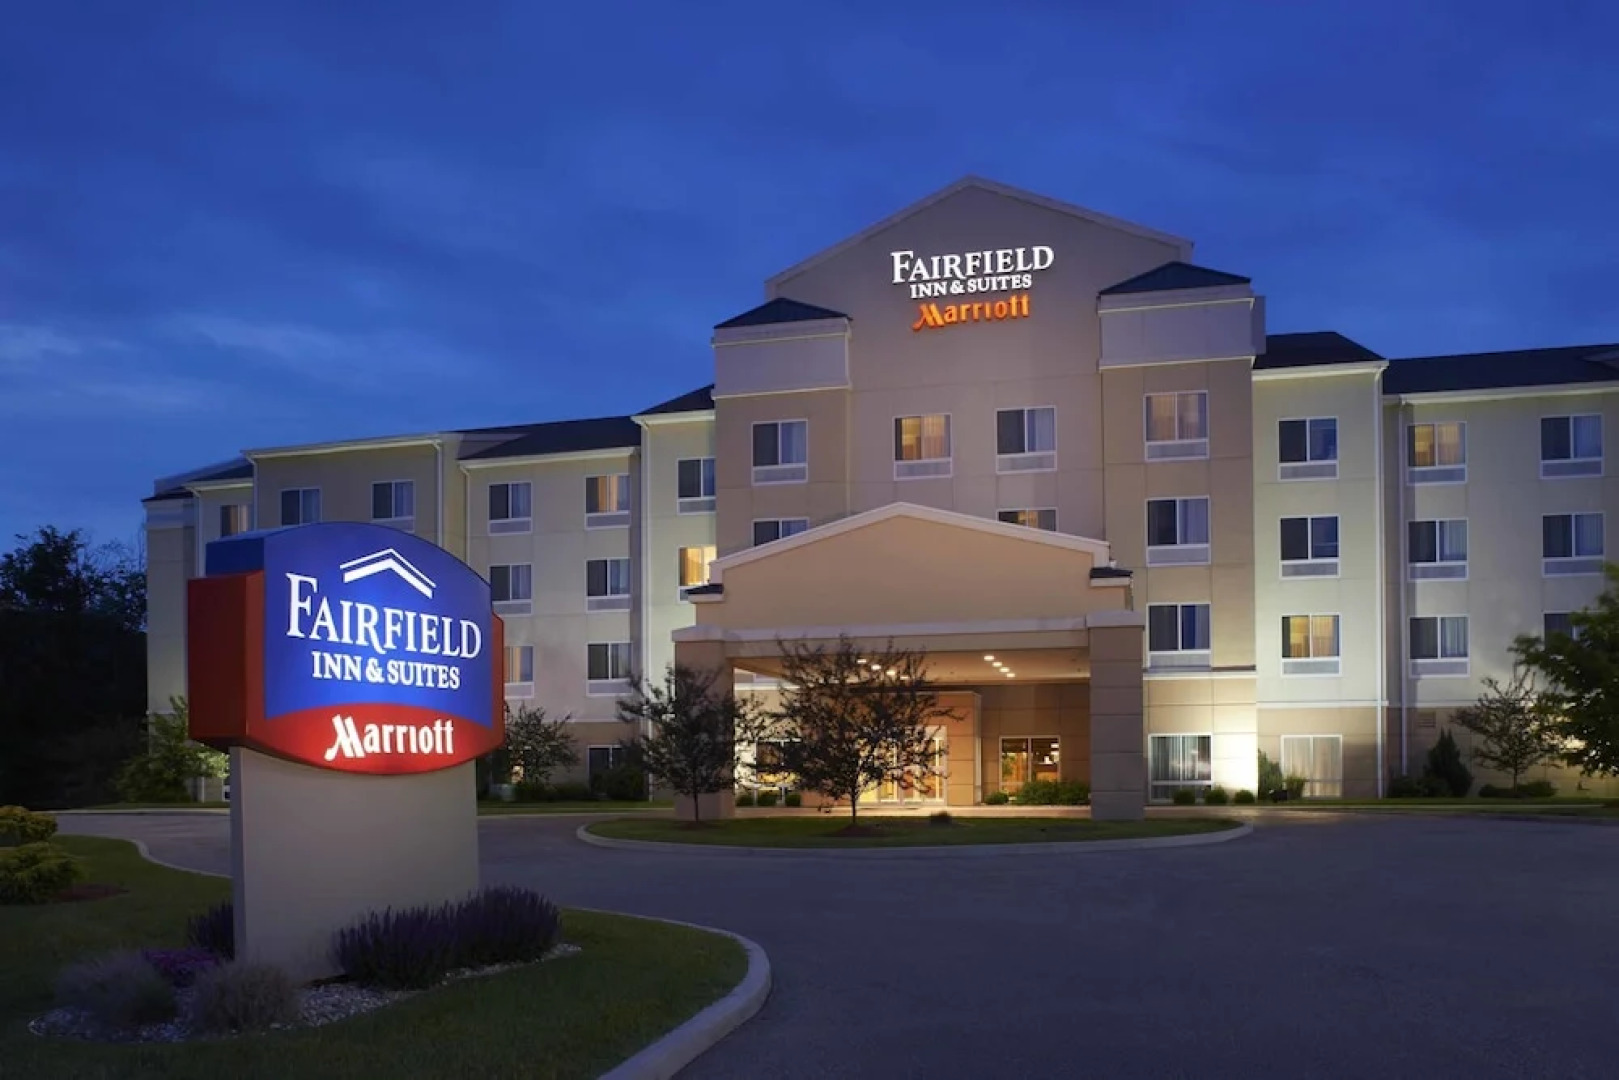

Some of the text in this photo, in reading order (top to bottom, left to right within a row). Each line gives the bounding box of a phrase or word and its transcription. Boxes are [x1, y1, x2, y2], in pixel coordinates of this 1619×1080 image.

[890, 245, 1055, 284] FAIRFIELD
[910, 274, 1032, 299] INN & SUITES
[912, 294, 1030, 331] Marriott
[285, 572, 482, 659] FAIRFIELD
[311, 650, 460, 690] INN & SUITES
[324, 714, 454, 762] Marriott
